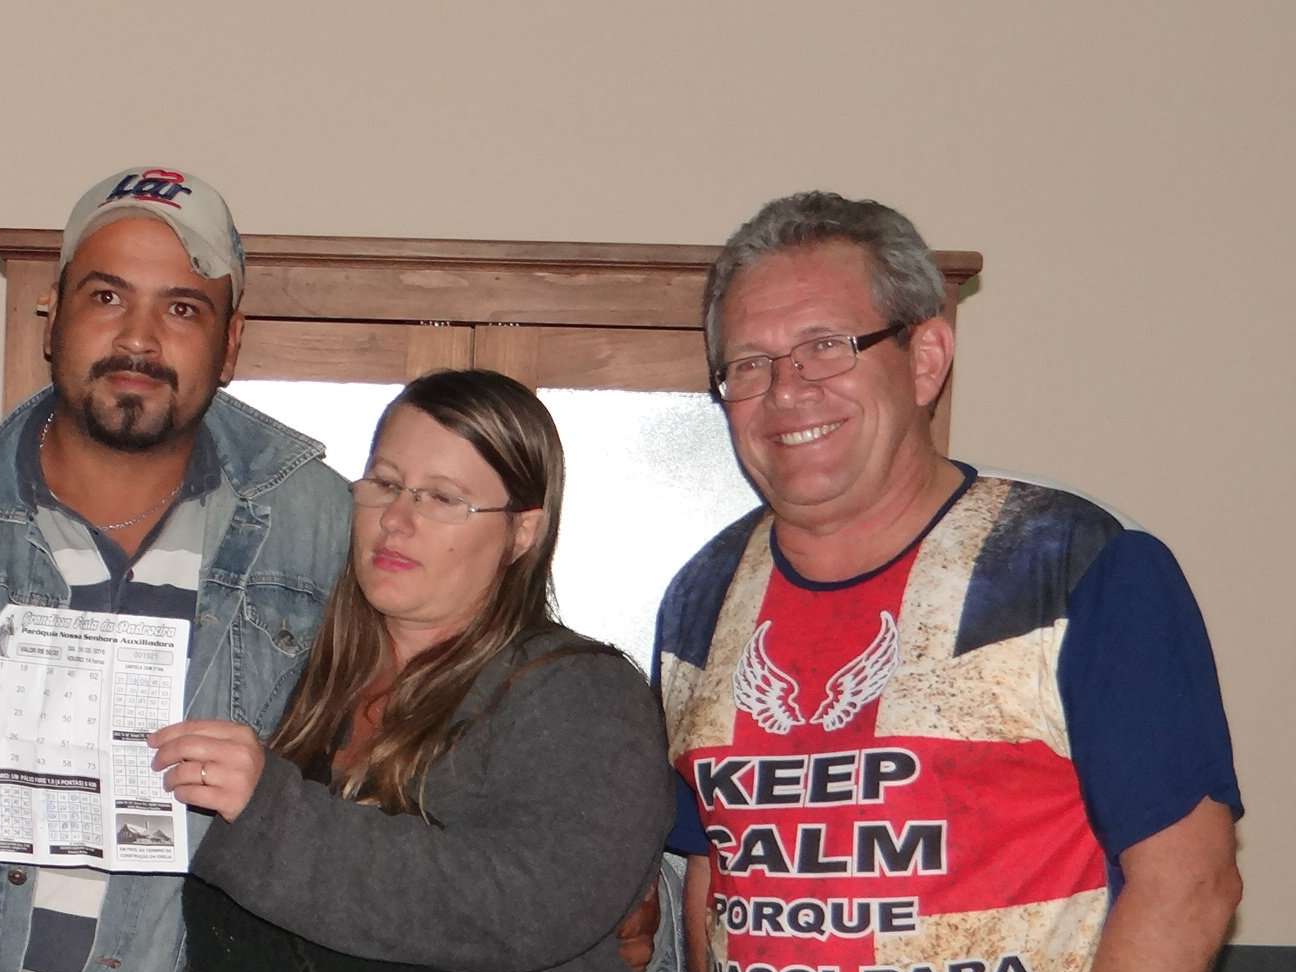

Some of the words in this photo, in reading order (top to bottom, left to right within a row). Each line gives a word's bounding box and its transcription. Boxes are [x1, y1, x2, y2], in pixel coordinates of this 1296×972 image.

[105, 174, 192, 201] Lar
[21, 627, 58, 637] Paróquia
[59, 631, 82, 639] Nossa
[83, 634, 118, 643] Senhora
[120, 637, 174, 648] Auxiliadora
[117, 620, 176, 637] Padroeira
[694, 748, 921, 810] KEEP
[713, 894, 920, 944] PORQUE
